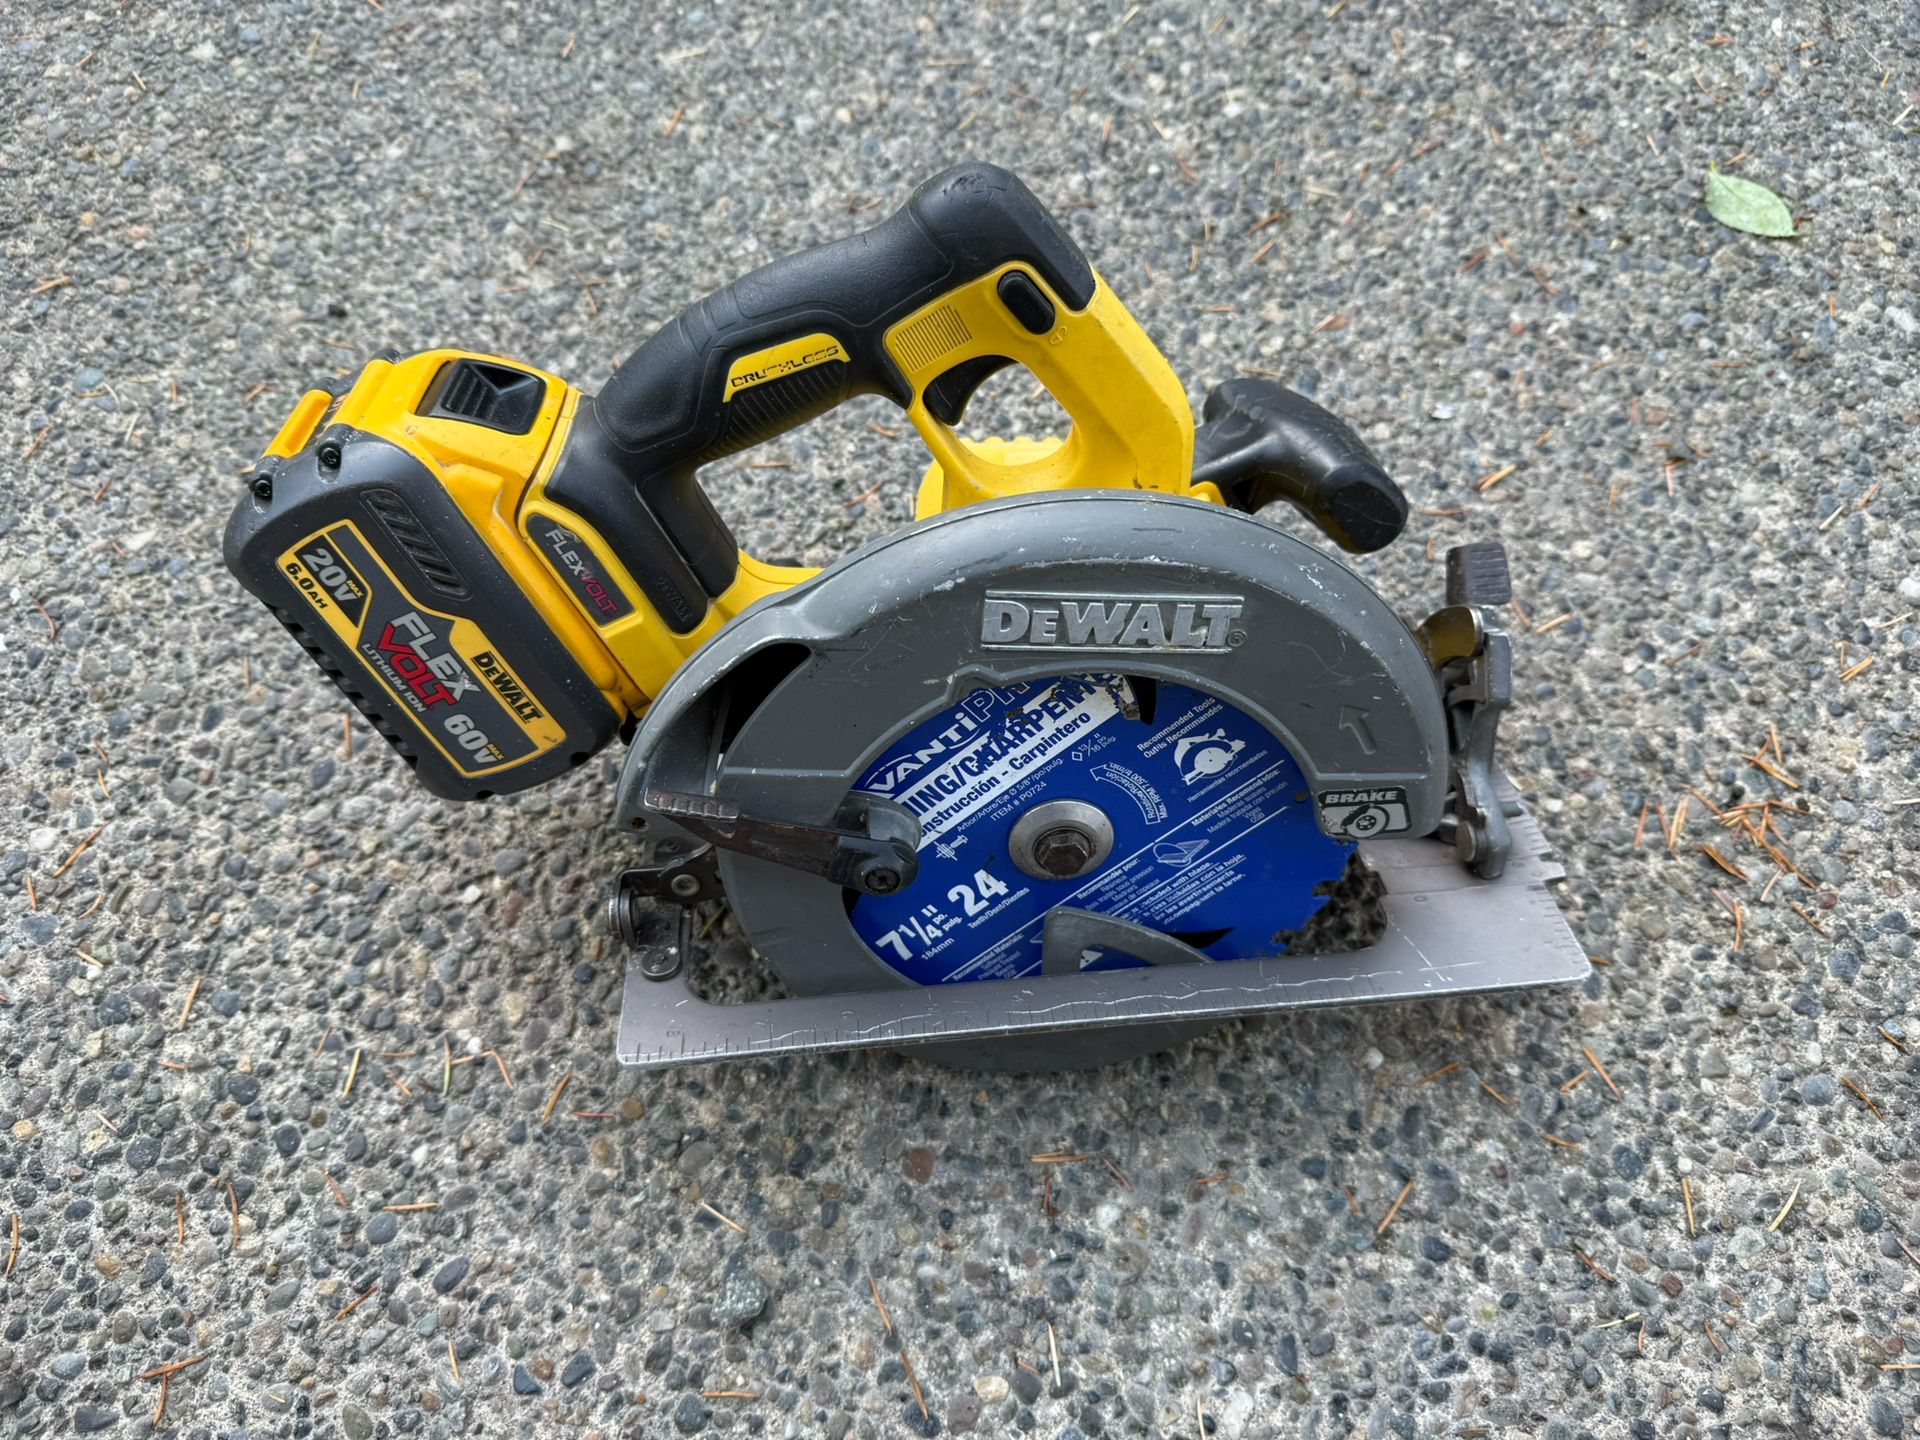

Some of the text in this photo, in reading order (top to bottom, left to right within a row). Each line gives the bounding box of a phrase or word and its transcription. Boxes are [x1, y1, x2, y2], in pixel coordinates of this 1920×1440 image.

[302, 547, 364, 603] 20V MAX
[981, 598, 1243, 647] DEWALT
[361, 641, 426, 714] LITHIUM ION
[378, 624, 456, 706] VOLT
[391, 611, 480, 701] FLEX
[471, 650, 544, 724] DEWALT
[444, 713, 505, 764] 60V MAX
[1009, 711, 1090, 770] Carpintero
[1137, 696, 1216, 751] Recommended Tools
[1142, 703, 1223, 759] Outils Recommandés
[990, 803, 1013, 821] ITEM
[1020, 780, 1047, 801] P0724
[1191, 800, 1226, 826] Materiales
[1325, 790, 1399, 804] BRAKE
[945, 868, 1010, 916] 24
[1171, 874, 1188, 888] with
[920, 936, 955, 961] 184mm
